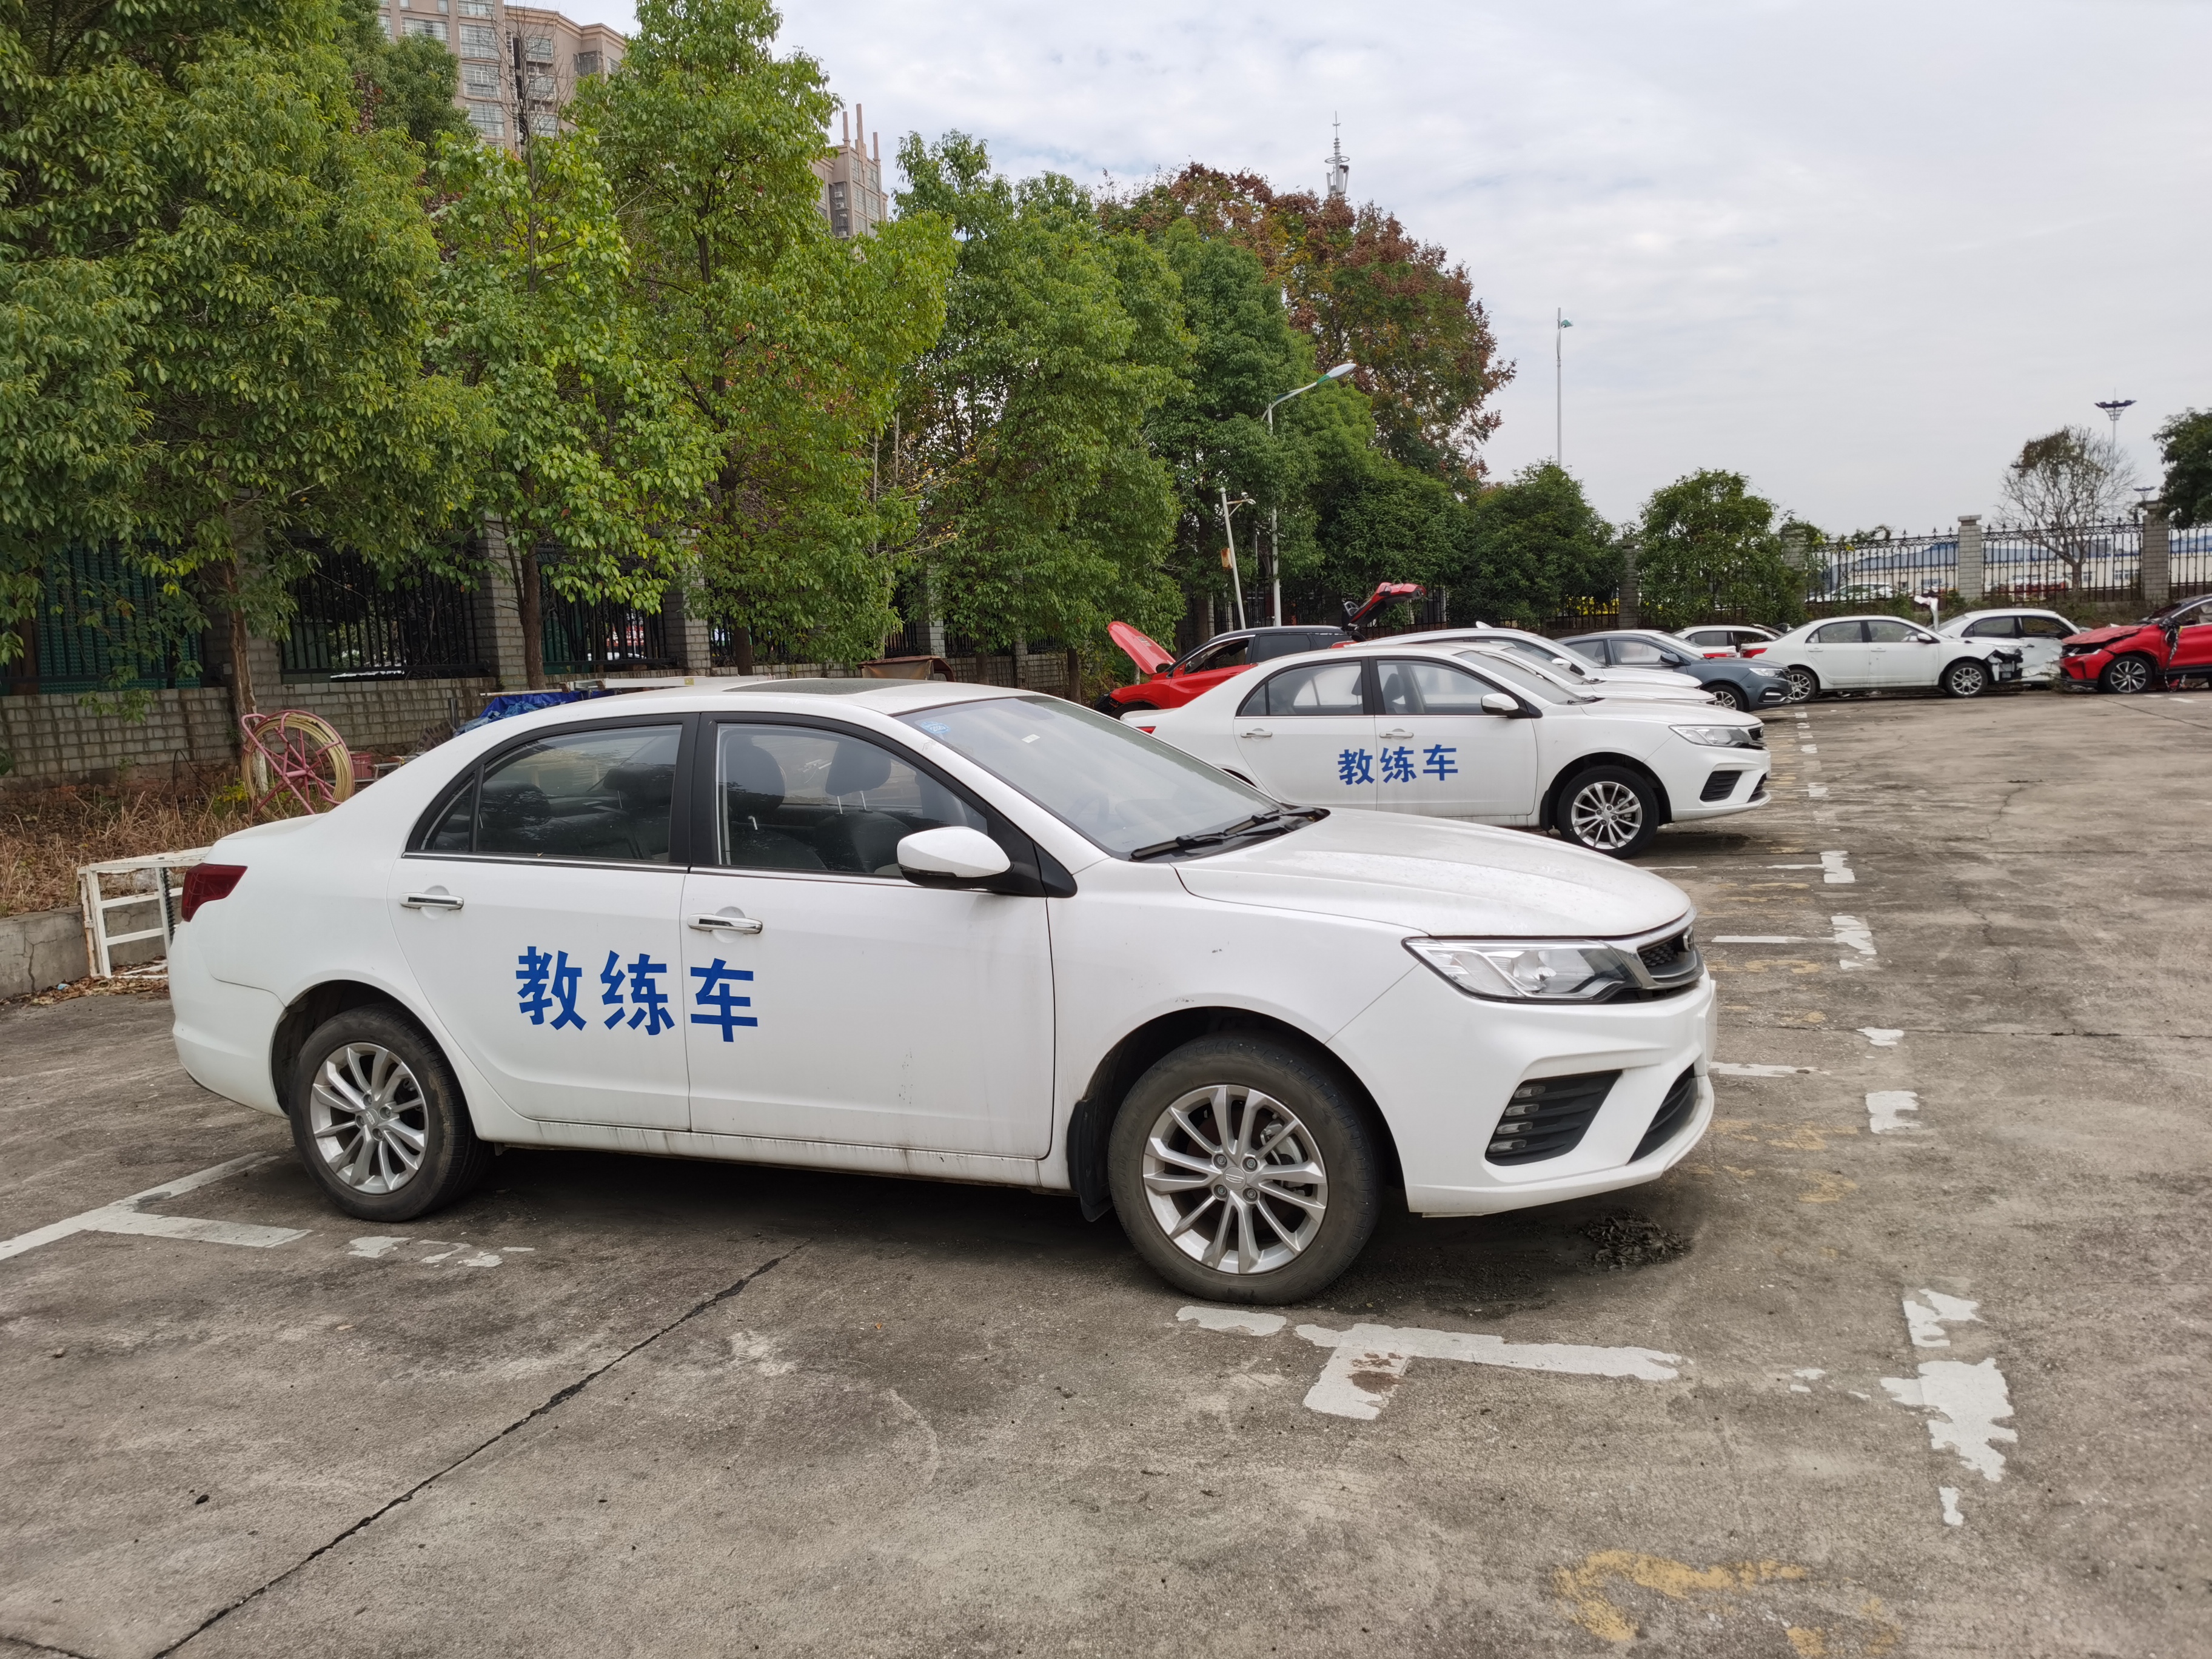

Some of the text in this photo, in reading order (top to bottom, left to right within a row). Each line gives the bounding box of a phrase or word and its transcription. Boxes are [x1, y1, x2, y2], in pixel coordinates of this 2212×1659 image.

[1338, 745, 1458, 785] 教练车
[515, 946, 758, 1042] 教练车
